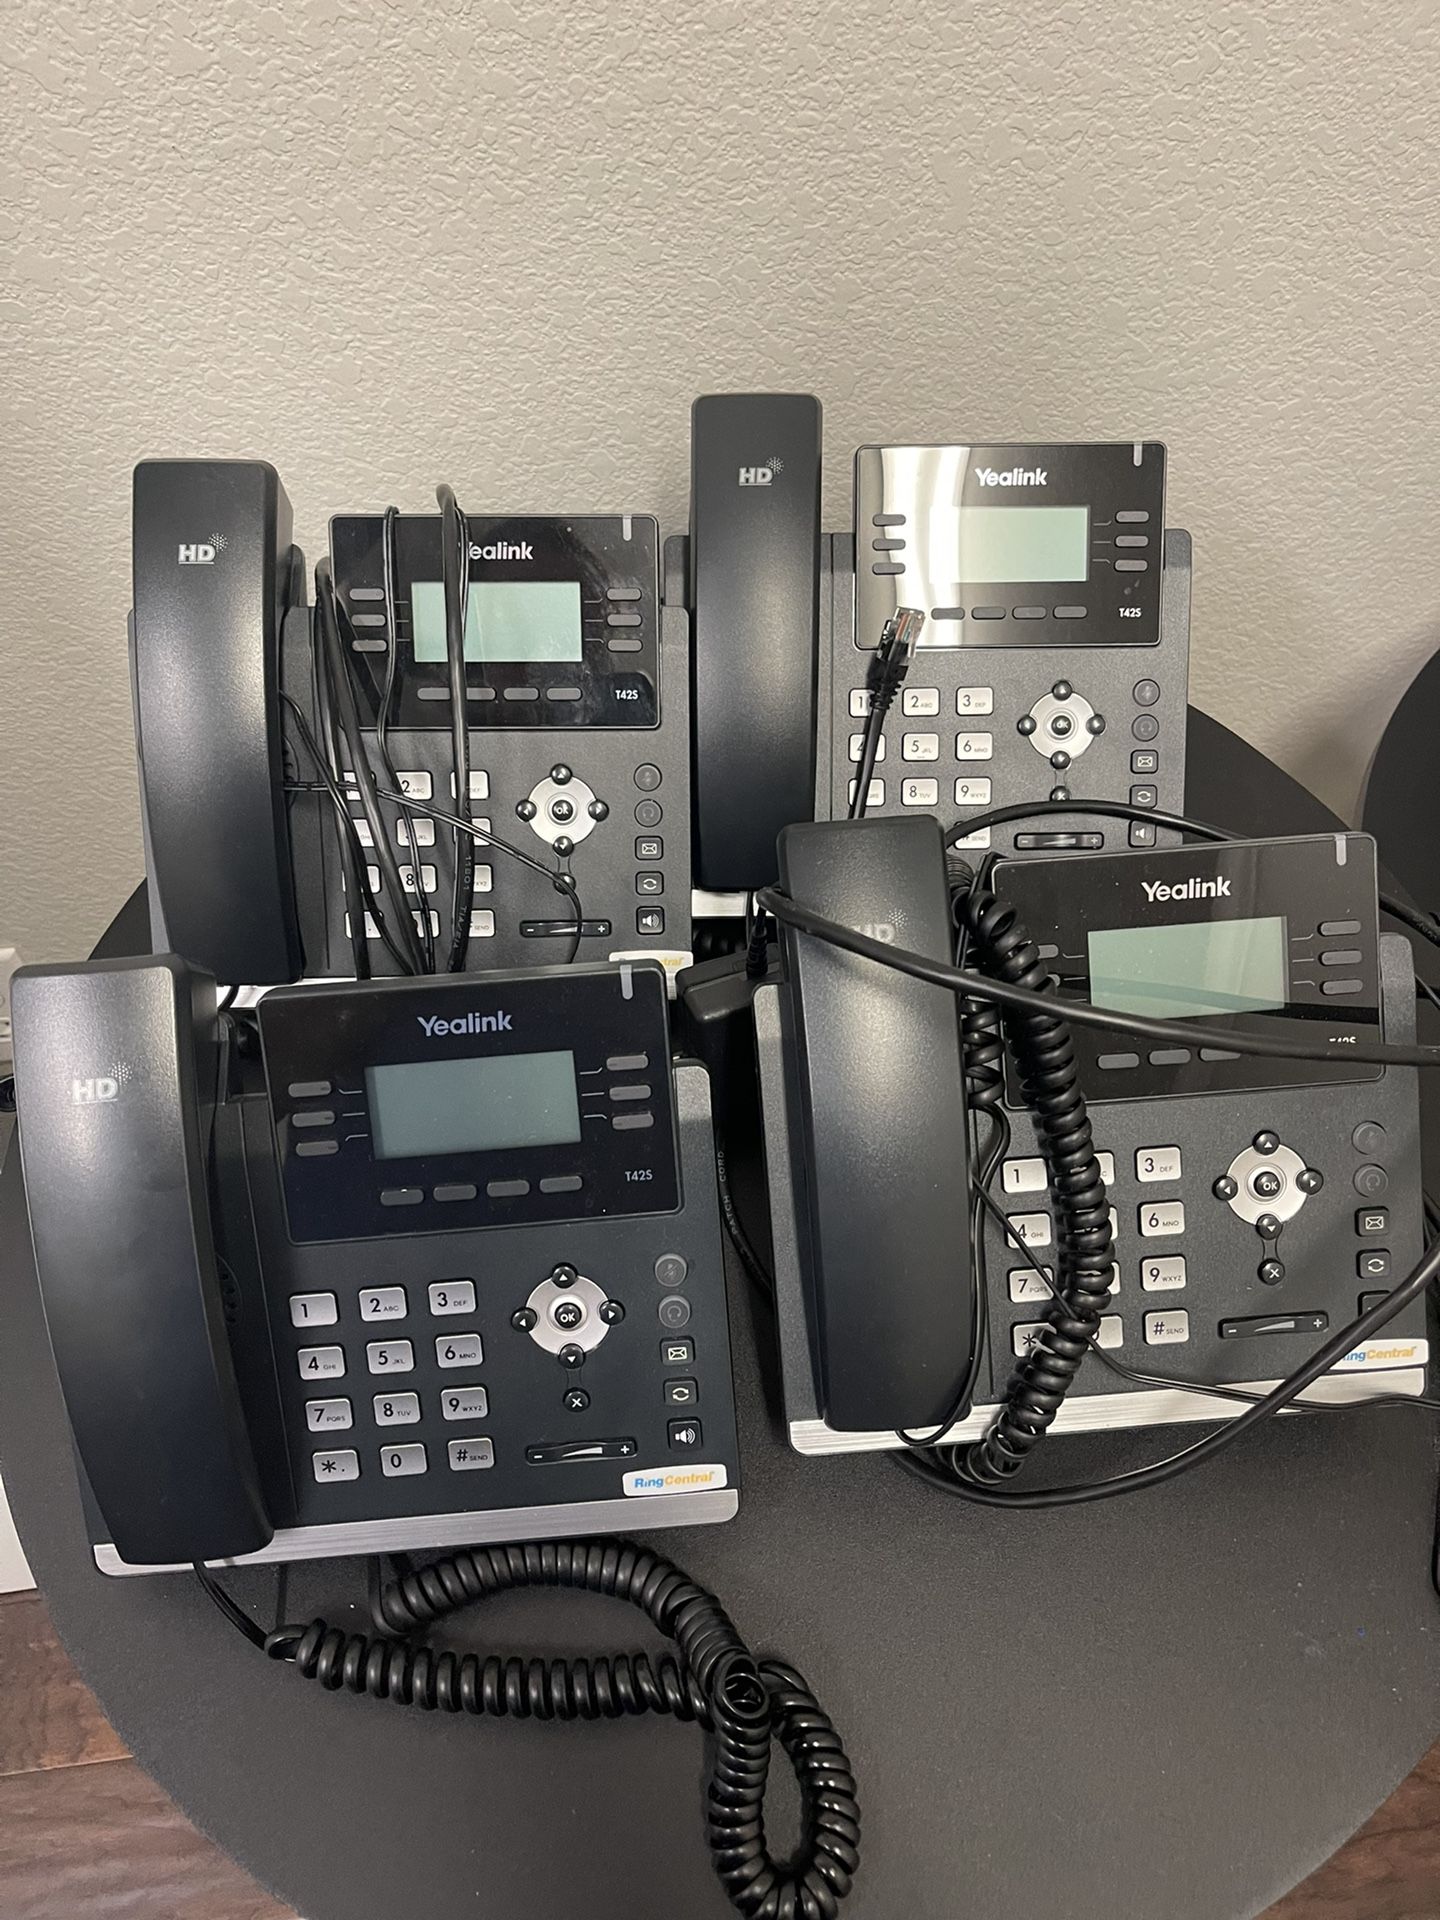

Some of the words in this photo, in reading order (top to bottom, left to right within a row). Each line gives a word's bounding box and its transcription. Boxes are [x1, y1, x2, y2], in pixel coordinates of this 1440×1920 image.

[739, 467, 773, 485] HD
[974, 467, 1048, 487] Yealink
[179, 544, 216, 563] HD
[1119, 607, 1142, 618] T42S
[615, 689, 639, 700] T42S
[911, 695, 919, 708] 2
[962, 694, 971, 707] 3
[911, 740, 919, 752] 5
[963, 740, 972, 753] 6
[401, 780, 411, 793] 2
[909, 785, 917, 798] 8
[960, 785, 969, 798] 9
[406, 873, 414, 886] 8
[1141, 876, 1231, 902] Yealink
[417, 1010, 512, 1036] Yealink
[72, 1077, 119, 1103] HD
[717, 1151, 727, 1182] CORD
[1144, 1158, 1155, 1173] 3
[624, 1169, 653, 1182] T42S
[1013, 1169, 1020, 1183] 1
[1263, 1181, 1278, 1191] OK
[1148, 1212, 1159, 1228] 6
[1150, 1267, 1160, 1282] 9
[1018, 1278, 1029, 1293] 7
[369, 1298, 381, 1313] 2
[437, 1292, 448, 1307] 3
[300, 1303, 308, 1318] 1
[560, 1312, 576, 1323] OK
[378, 1350, 389, 1366] 5
[444, 1345, 456, 1360] 6
[1343, 1347, 1414, 1362] ingCentral
[308, 1356, 319, 1371] 4
[383, 1403, 394, 1418] 8
[449, 1397, 460, 1412] 9
[314, 1408, 325, 1423] 7
[390, 1454, 402, 1468] 0
[635, 1471, 712, 1489] RingCentral
